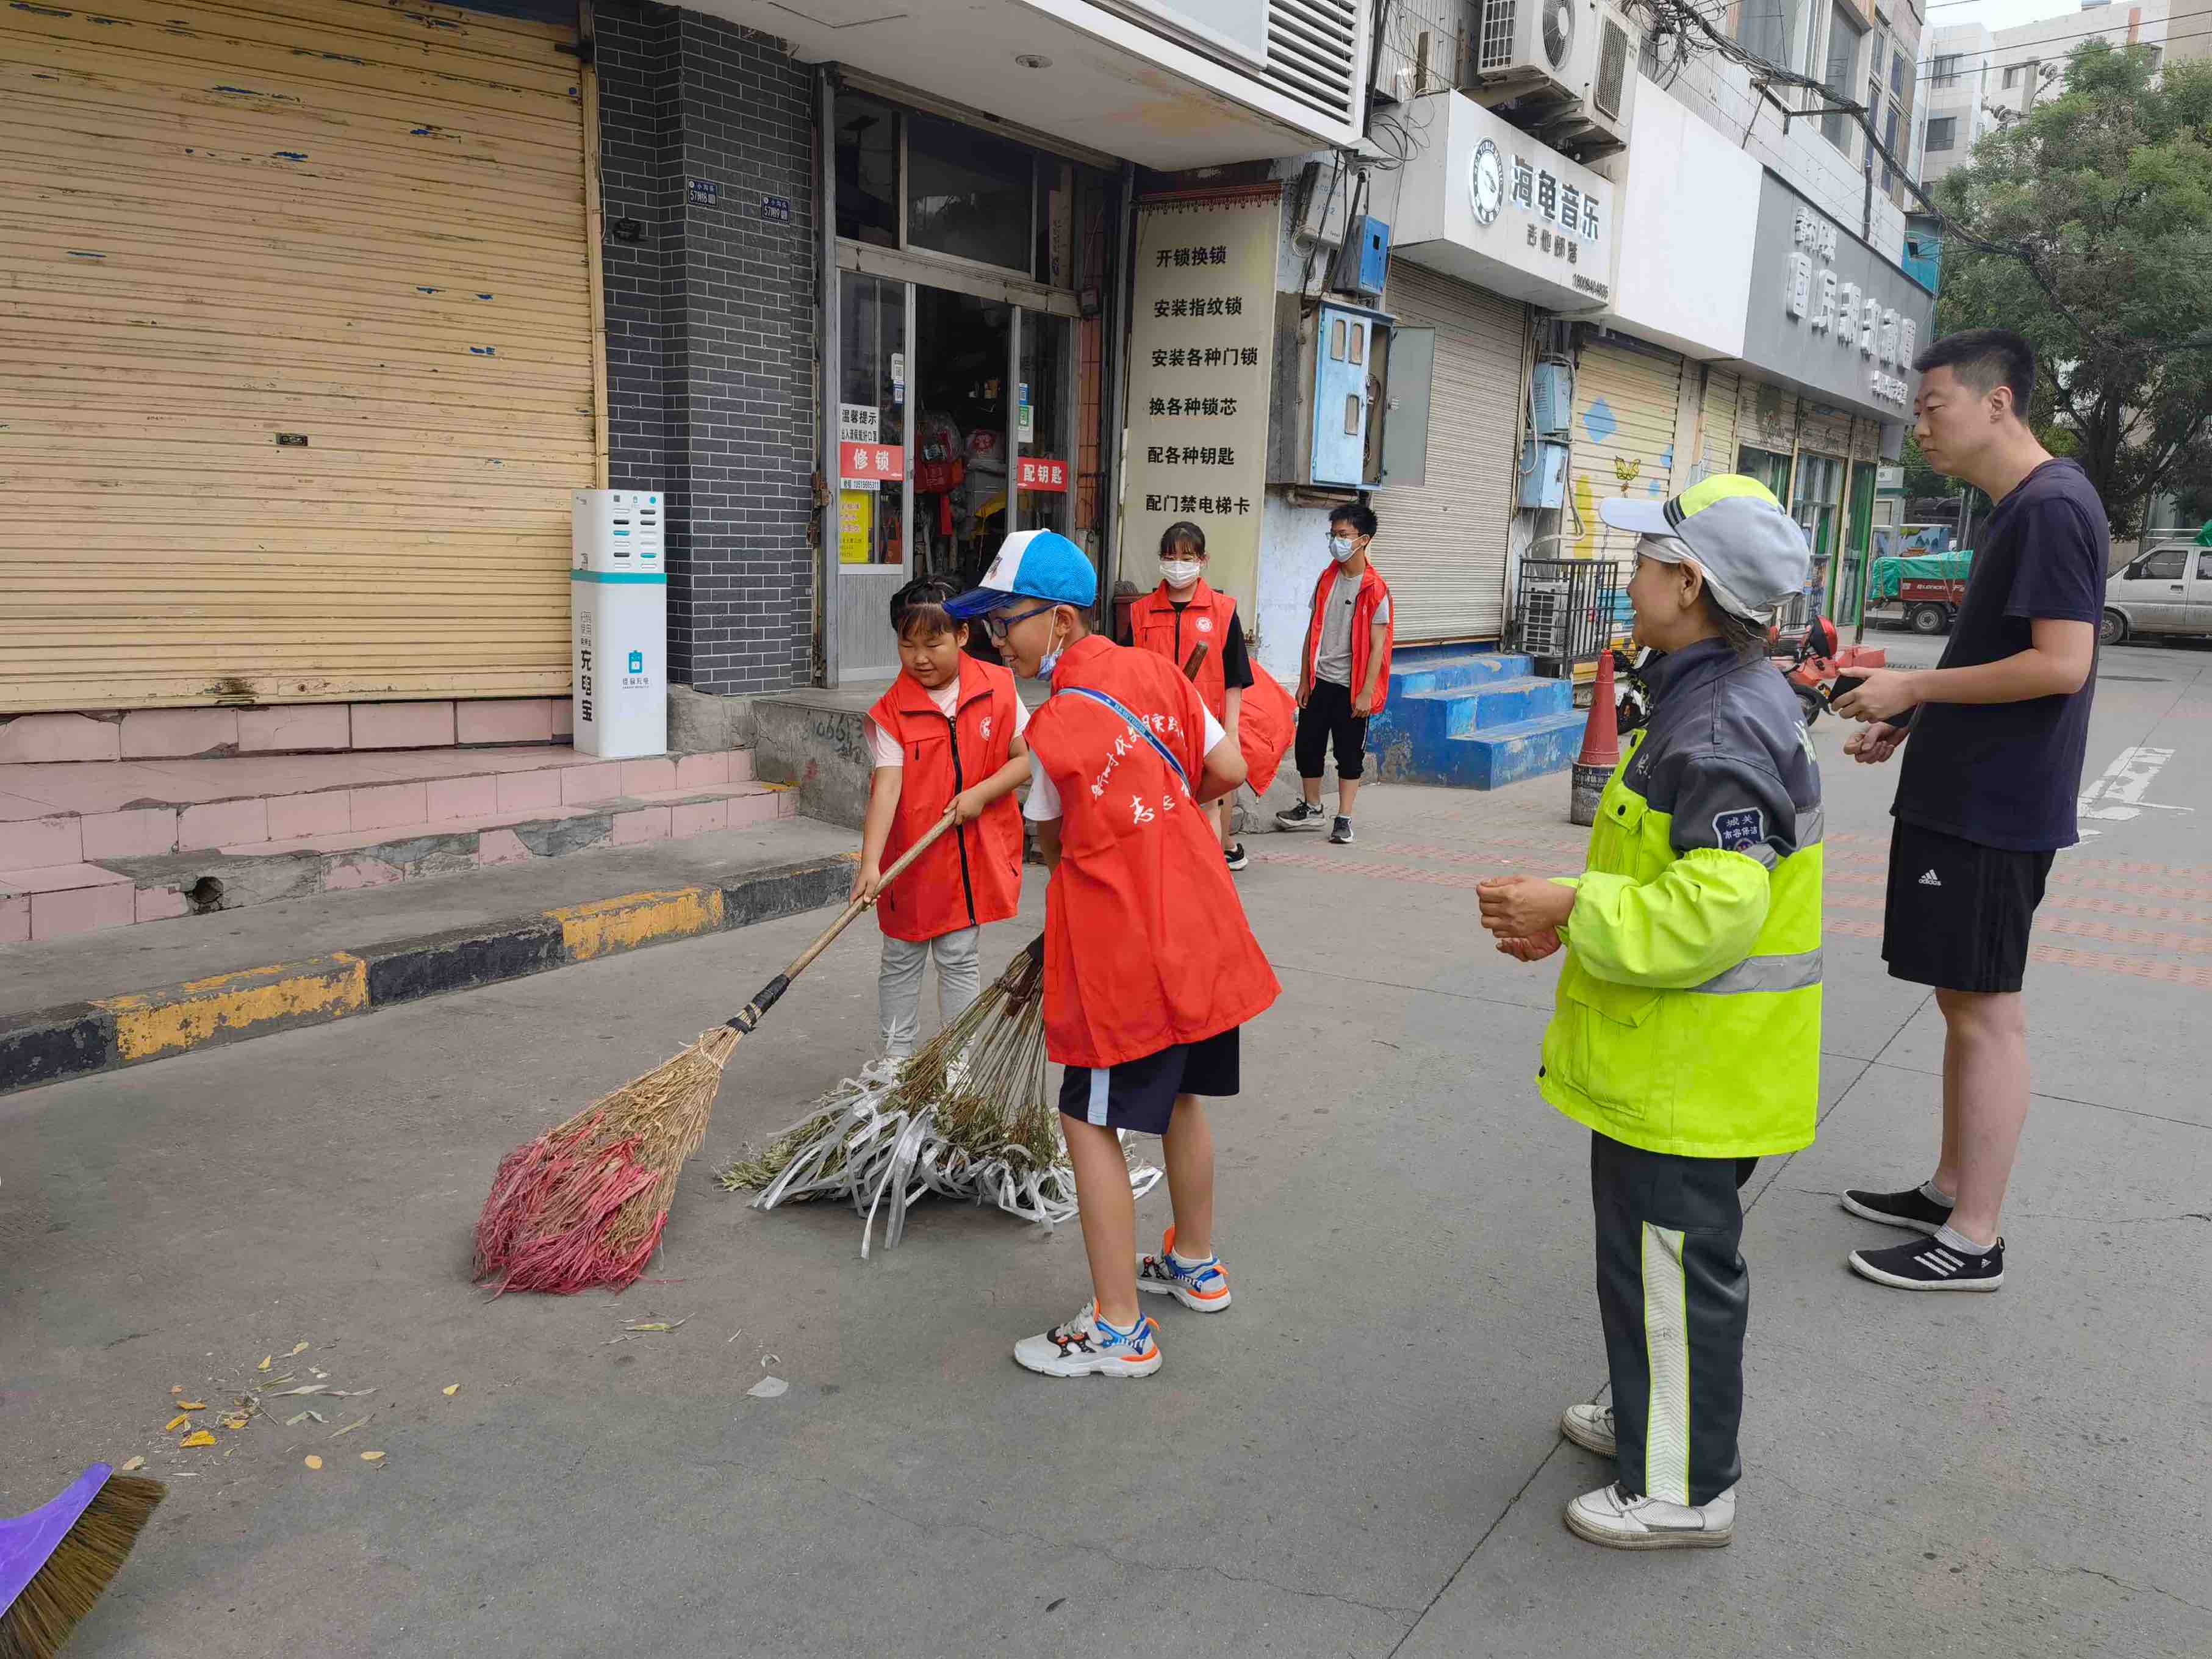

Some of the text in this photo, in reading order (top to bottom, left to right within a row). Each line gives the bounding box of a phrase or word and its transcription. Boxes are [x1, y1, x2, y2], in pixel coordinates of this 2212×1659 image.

[1510, 154, 1599, 240] 海龟音乐
[1526, 223, 1578, 264] 吉他部落
[1155, 245, 1227, 268] 开锁换锁
[1154, 296, 1243, 318] 安装指纹锁
[1151, 347, 1258, 367] 安装各种门锁
[842, 409, 877, 425] 温馨提示
[1149, 397, 1238, 416] 换各种锁芯
[853, 448, 889, 472] 修锁
[1147, 445, 1235, 466] 配各种钥匙
[1023, 464, 1063, 484] 配钥匙
[1146, 494, 1250, 515] 配门禁电梯卡
